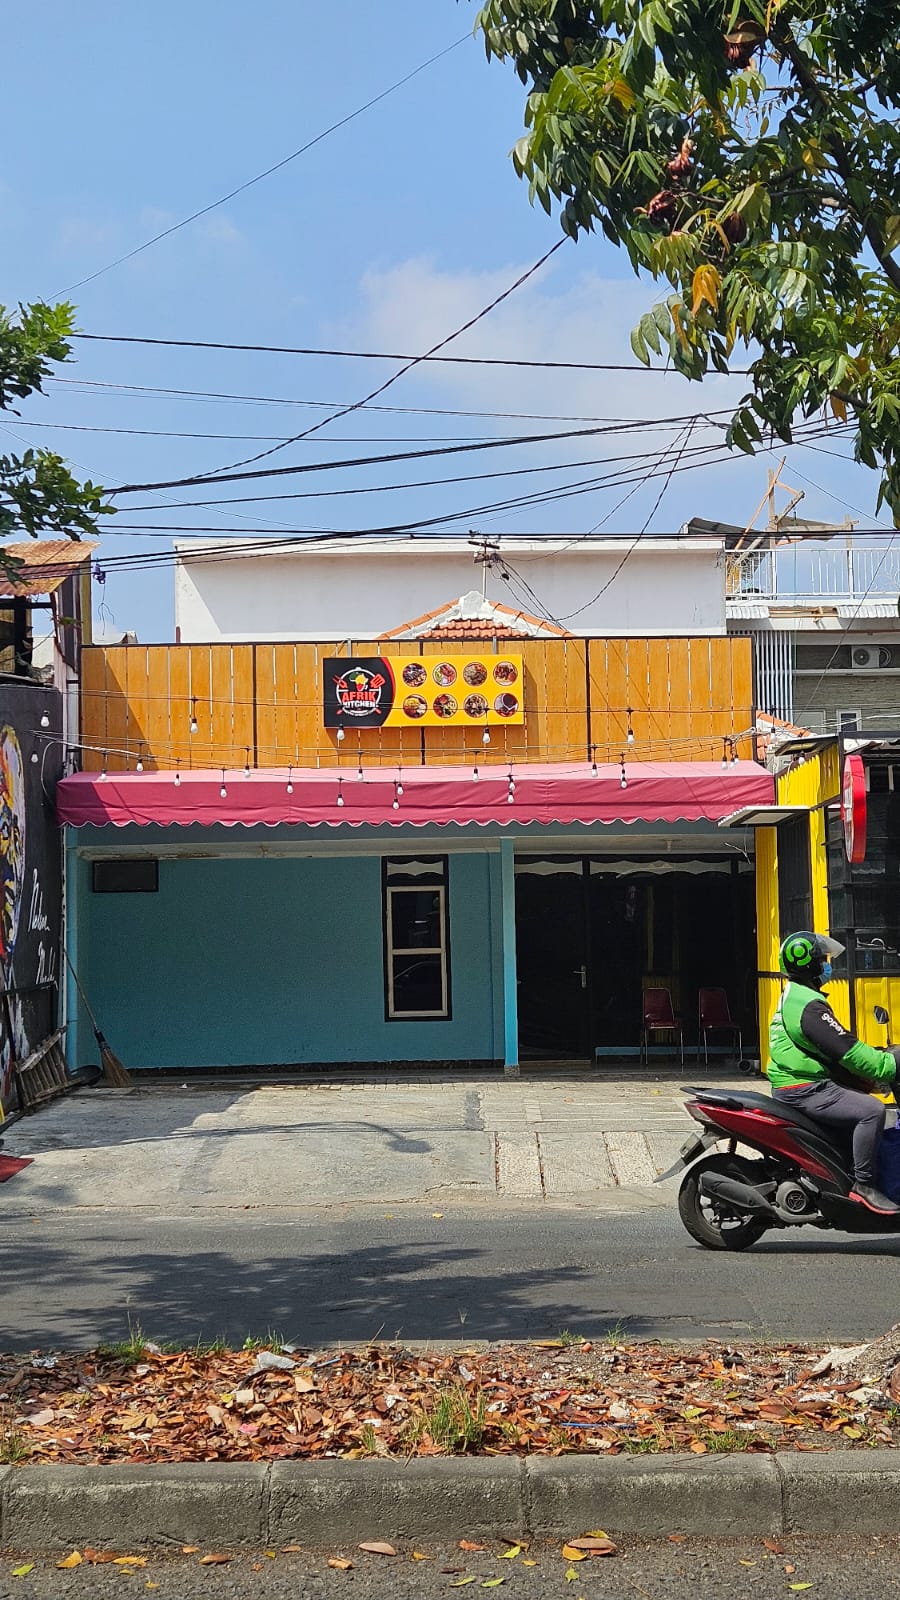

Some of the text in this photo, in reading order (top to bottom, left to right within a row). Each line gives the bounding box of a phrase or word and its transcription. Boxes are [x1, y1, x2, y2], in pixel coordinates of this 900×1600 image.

[342, 692, 376, 702] AFRIK
[342, 700, 376, 709] KITCHEN
[821, 1013, 846, 1035] gopay
